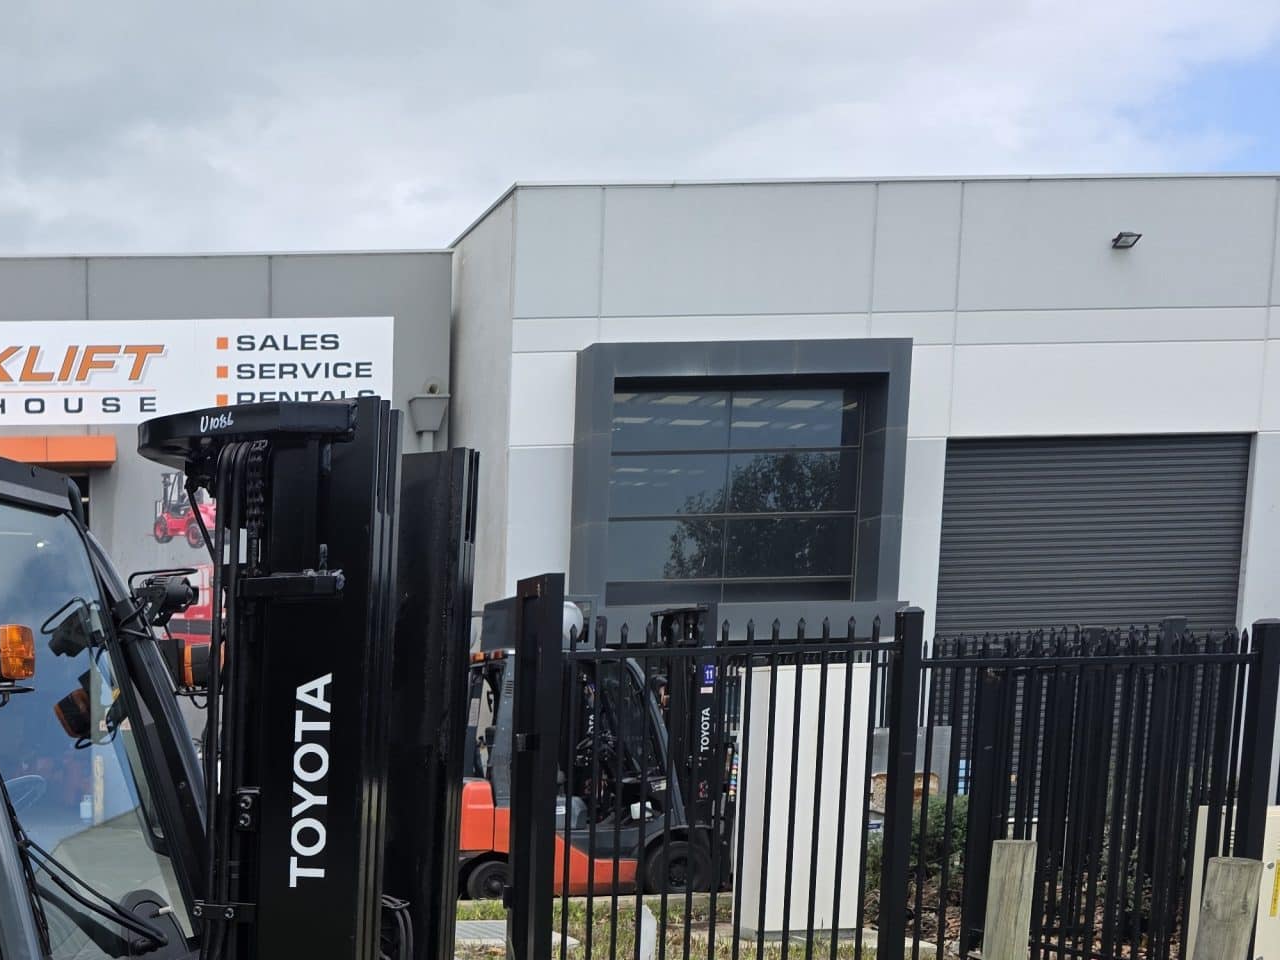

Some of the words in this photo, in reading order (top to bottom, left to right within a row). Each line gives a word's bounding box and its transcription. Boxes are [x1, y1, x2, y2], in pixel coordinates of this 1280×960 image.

[236, 334, 340, 351] SALES
[236, 362, 373, 379] SERVICE
[700, 707, 711, 752] TOYOTA
[288, 672, 333, 888] TOYOTA
